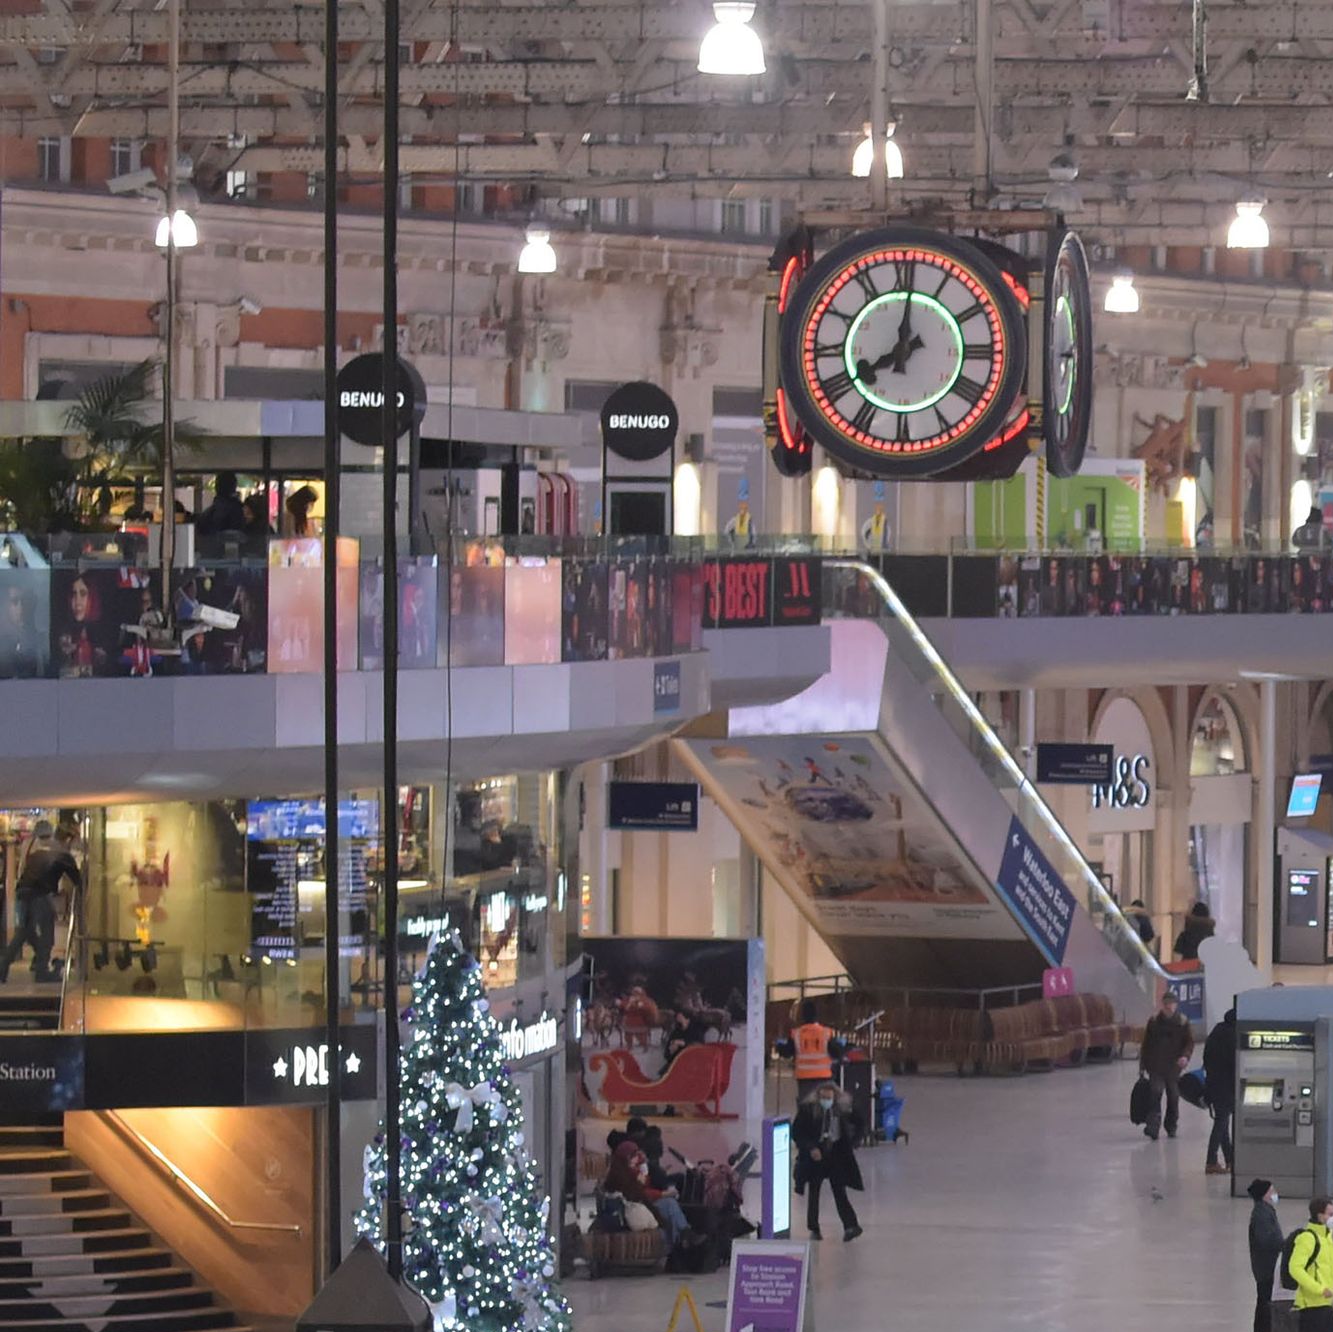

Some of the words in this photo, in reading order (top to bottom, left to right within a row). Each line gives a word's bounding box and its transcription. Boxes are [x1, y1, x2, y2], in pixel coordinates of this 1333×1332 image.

[340, 391, 404, 408] BENUO
[609, 414, 669, 429] BENUGO
[724, 562, 769, 620] BEST
[1023, 846, 1053, 899] Waterloo
[500, 1010, 557, 1059] nfomation
[293, 1044, 341, 1086] PRE
